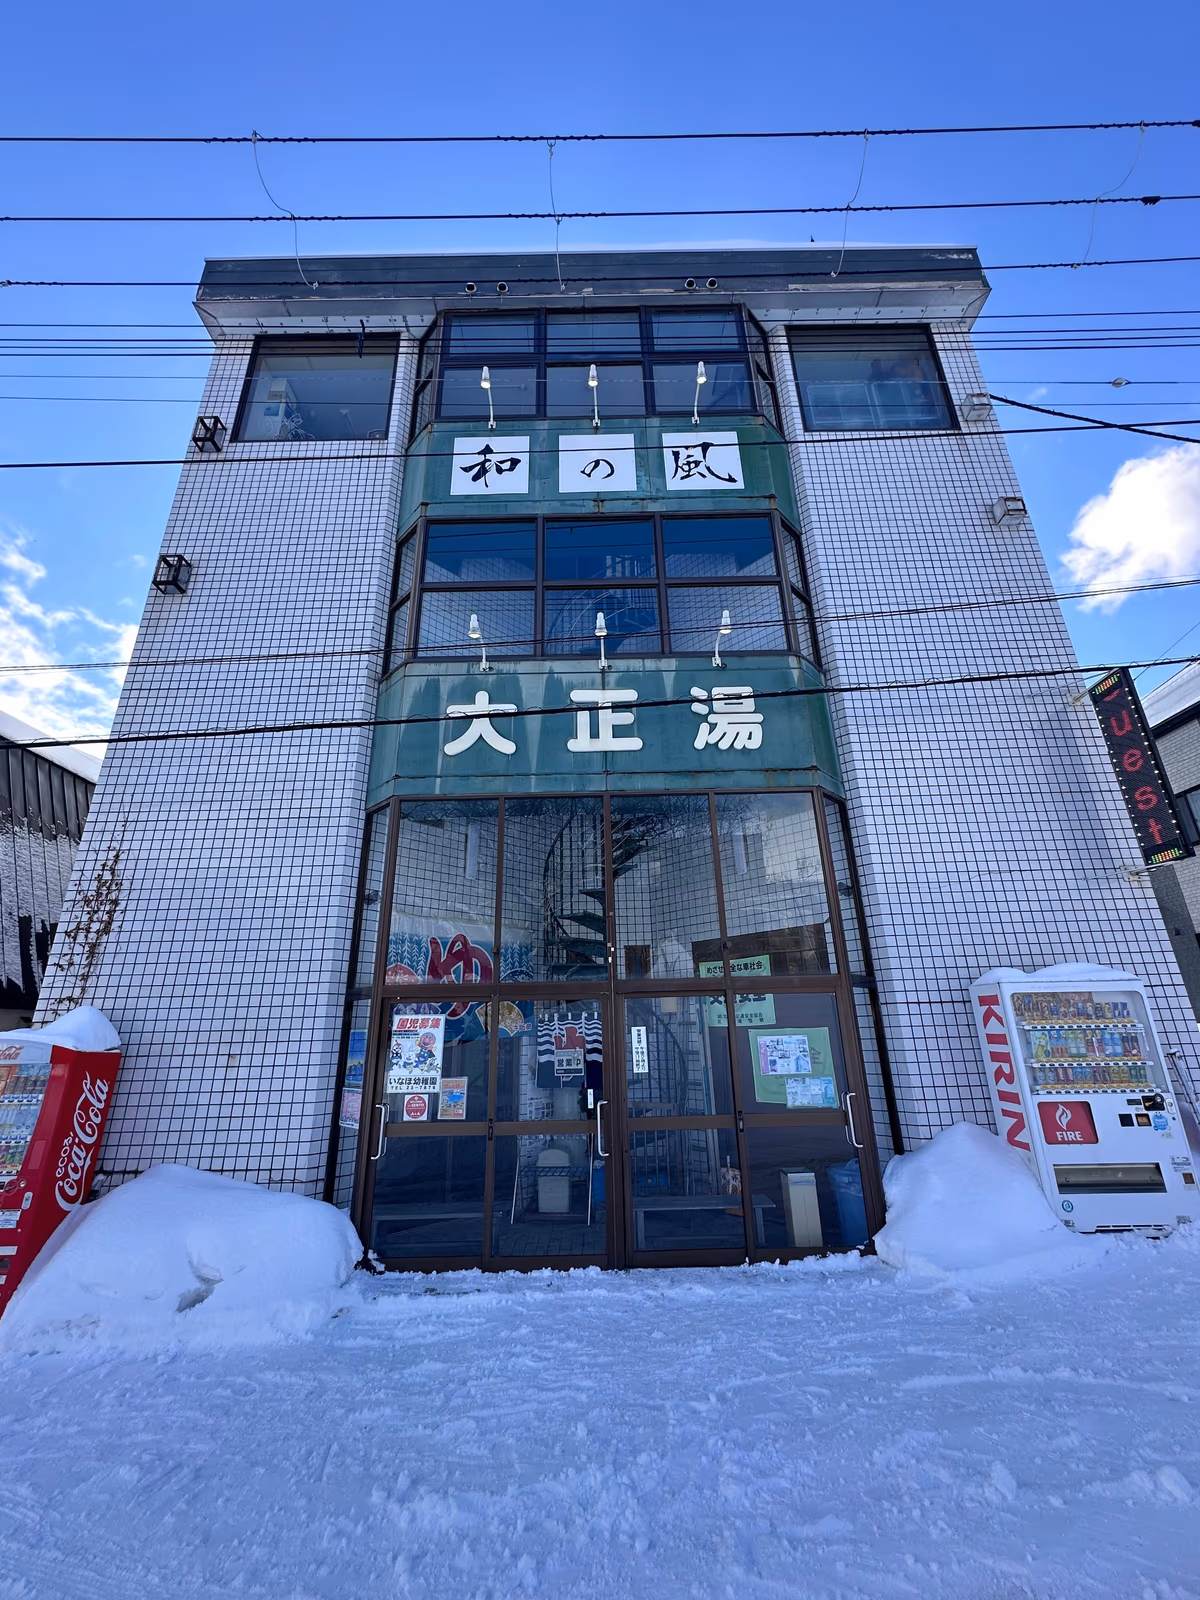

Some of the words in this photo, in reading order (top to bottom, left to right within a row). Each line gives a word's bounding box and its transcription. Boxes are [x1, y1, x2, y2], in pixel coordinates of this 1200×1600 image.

[459, 442, 738, 488] 和の風
[443, 686, 765, 756] 大正湯
[1103, 689, 1162, 844] uest
[706, 960, 763, 974] めざせ全な車社会
[396, 1017, 442, 1030] 園児募集
[389, 1076, 438, 1086] いなほ幼稚園
[977, 994, 1031, 1152] KIRIN
[55, 1071, 109, 1212] Coca-Cola
[1056, 1131, 1083, 1142] FIRE
